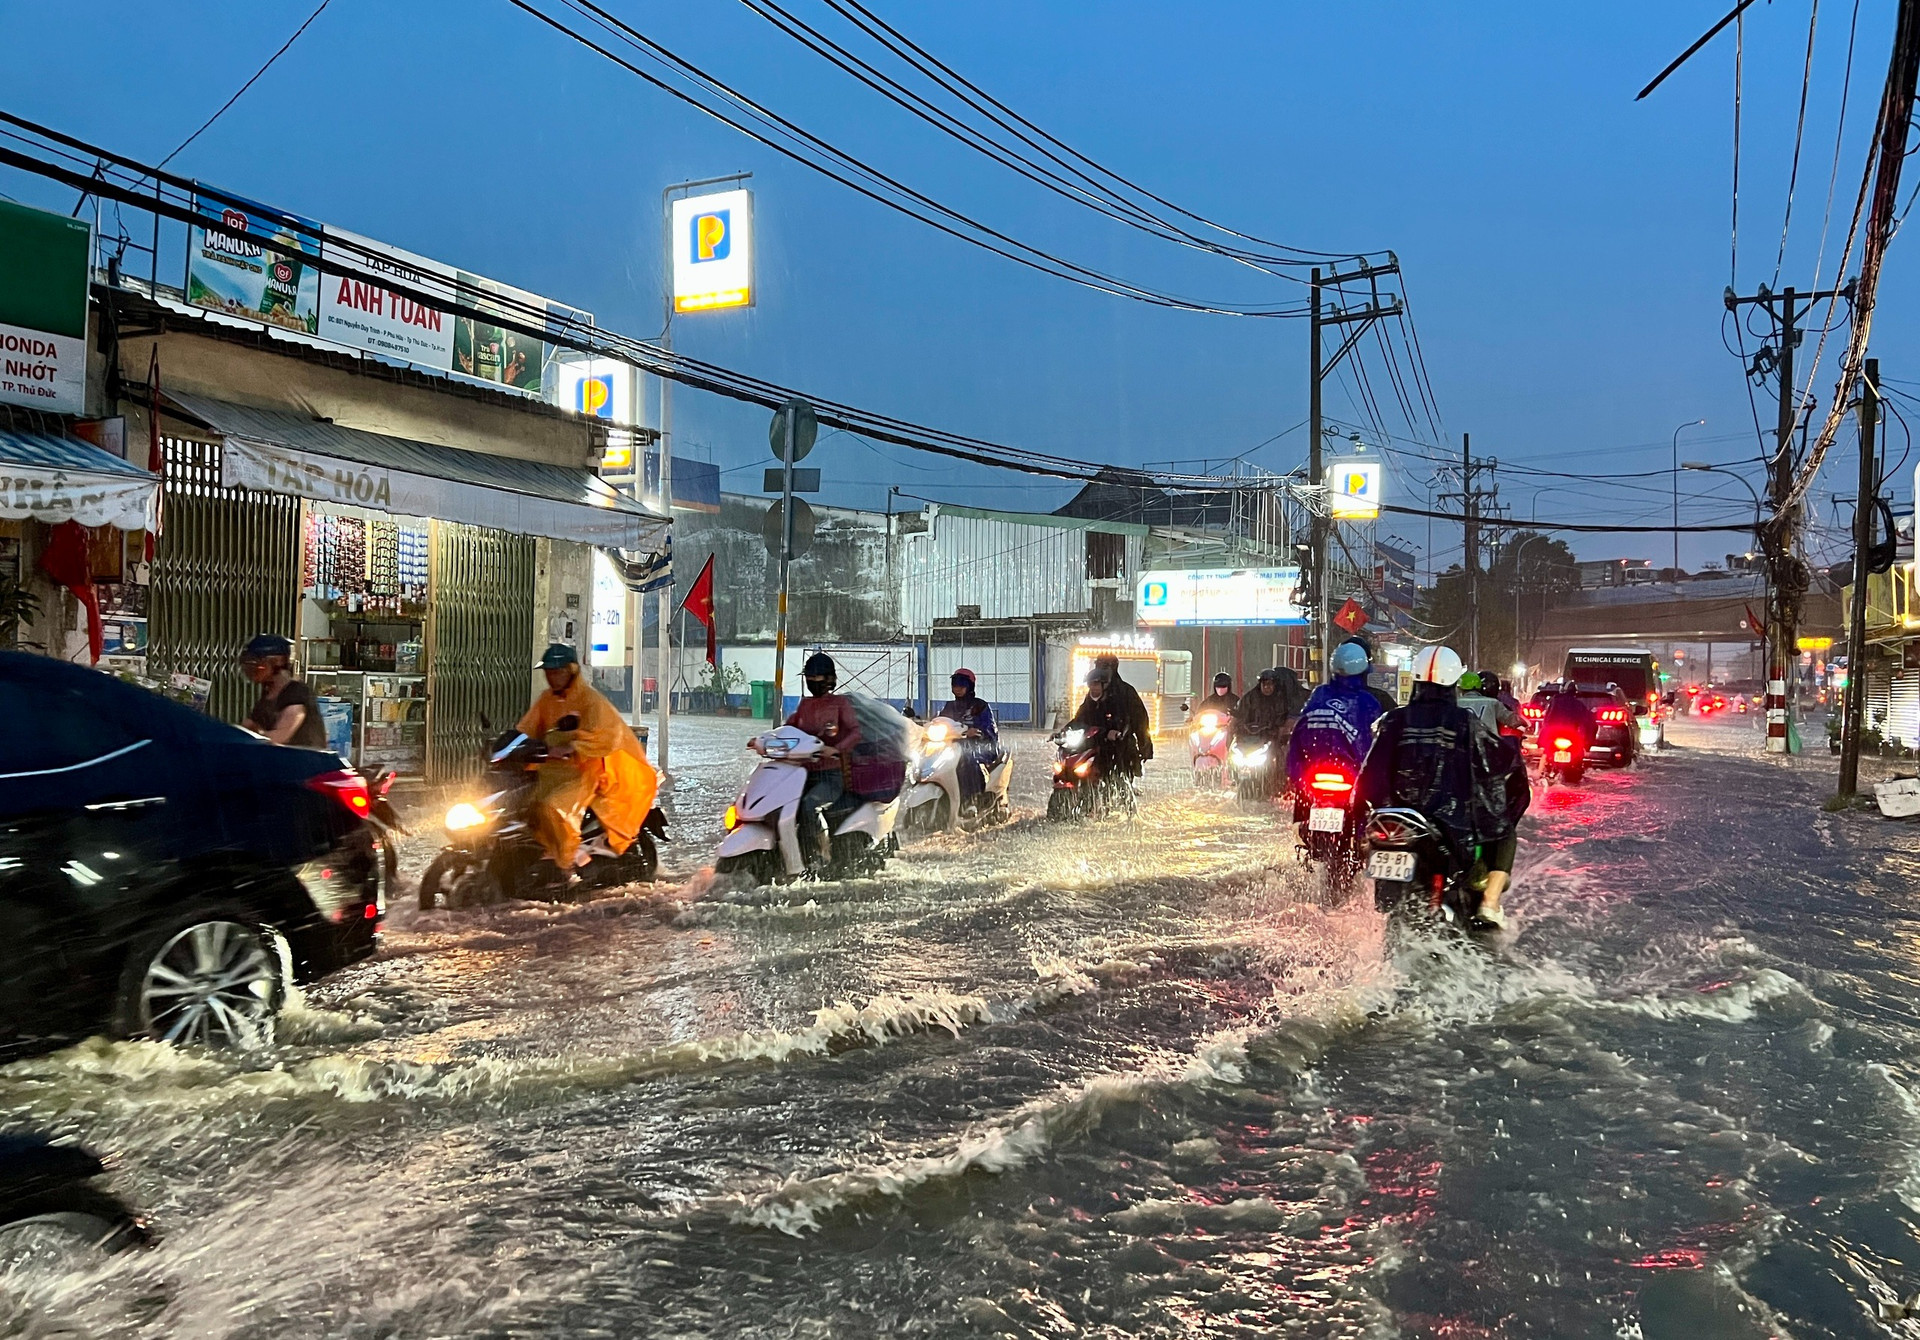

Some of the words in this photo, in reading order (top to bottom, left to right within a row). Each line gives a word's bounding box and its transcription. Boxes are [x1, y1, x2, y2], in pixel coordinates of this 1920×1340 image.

[337, 277, 382, 316] ANH
[6, 359, 57, 382] NHỚT
[17, 383, 35, 395] Thủ
[37, 387, 57, 398] Đức
[334, 466, 391, 506] HÓA
[607, 609, 620, 625] 22h
[1375, 852, 1408, 866] 59-B1
